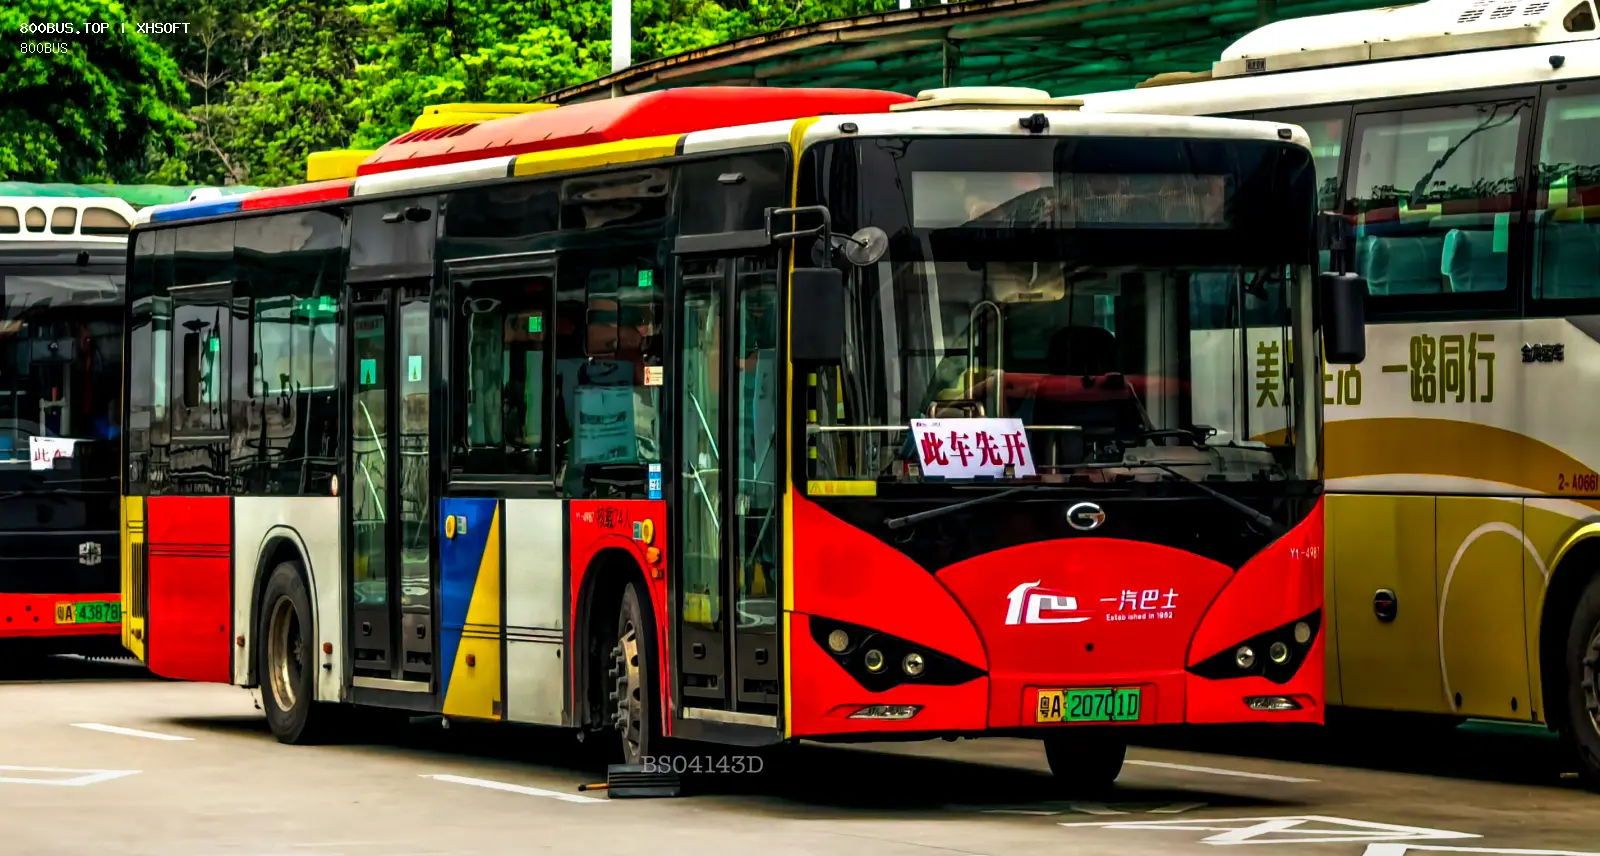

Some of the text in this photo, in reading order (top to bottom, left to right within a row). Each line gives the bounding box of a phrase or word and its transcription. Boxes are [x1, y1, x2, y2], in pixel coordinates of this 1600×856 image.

[1382, 332, 1496, 404] 一路同行
[920, 430, 1026, 467] 此车先开
[1099, 587, 1179, 611] 一汽巴士
[57, 603, 122, 621] 粤A43878
[1105, 612, 1147, 622] Estabished
